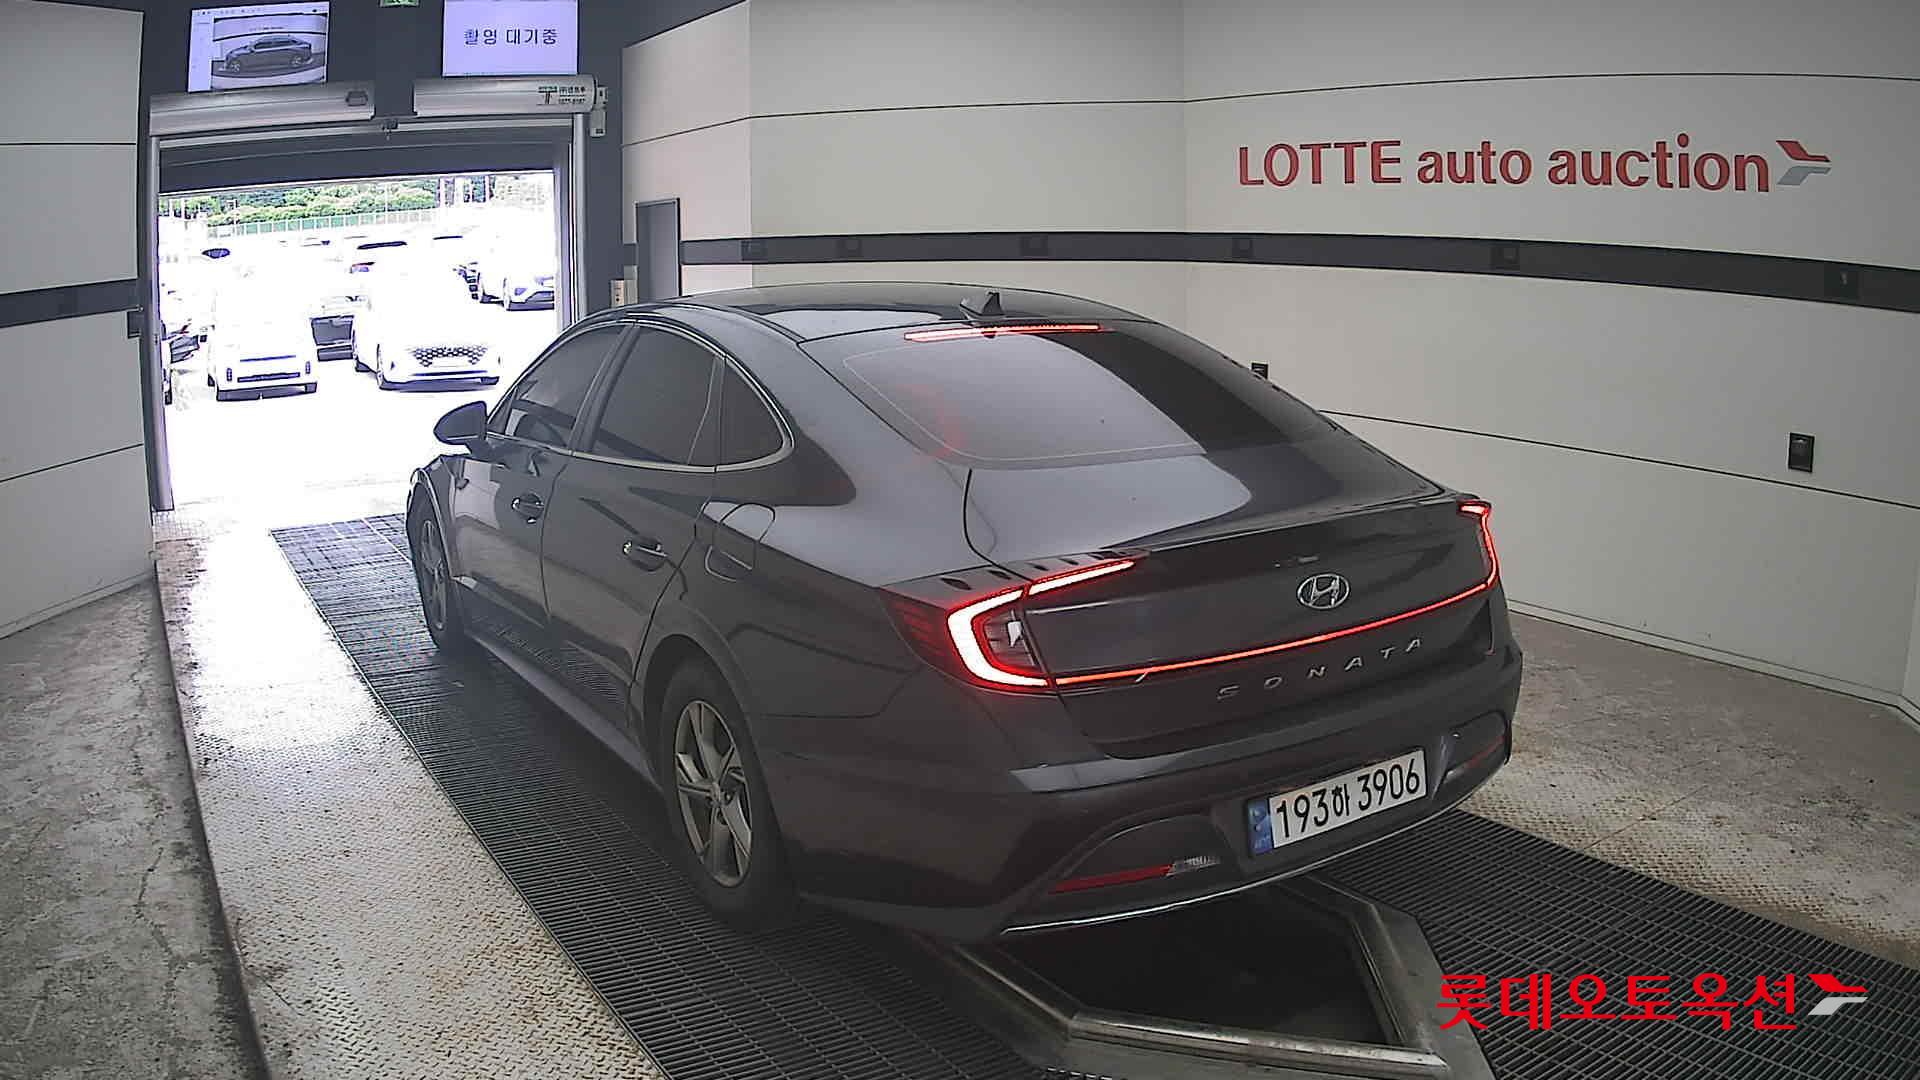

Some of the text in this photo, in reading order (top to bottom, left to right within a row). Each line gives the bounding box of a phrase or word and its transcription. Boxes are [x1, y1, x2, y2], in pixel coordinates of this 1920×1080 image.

[506, 28, 558, 45] 대기중
[1238, 133, 1770, 193] LOTTE auto auction
[1217, 637, 1424, 700] SONATA
[1276, 758, 1420, 838] 193하 3906
